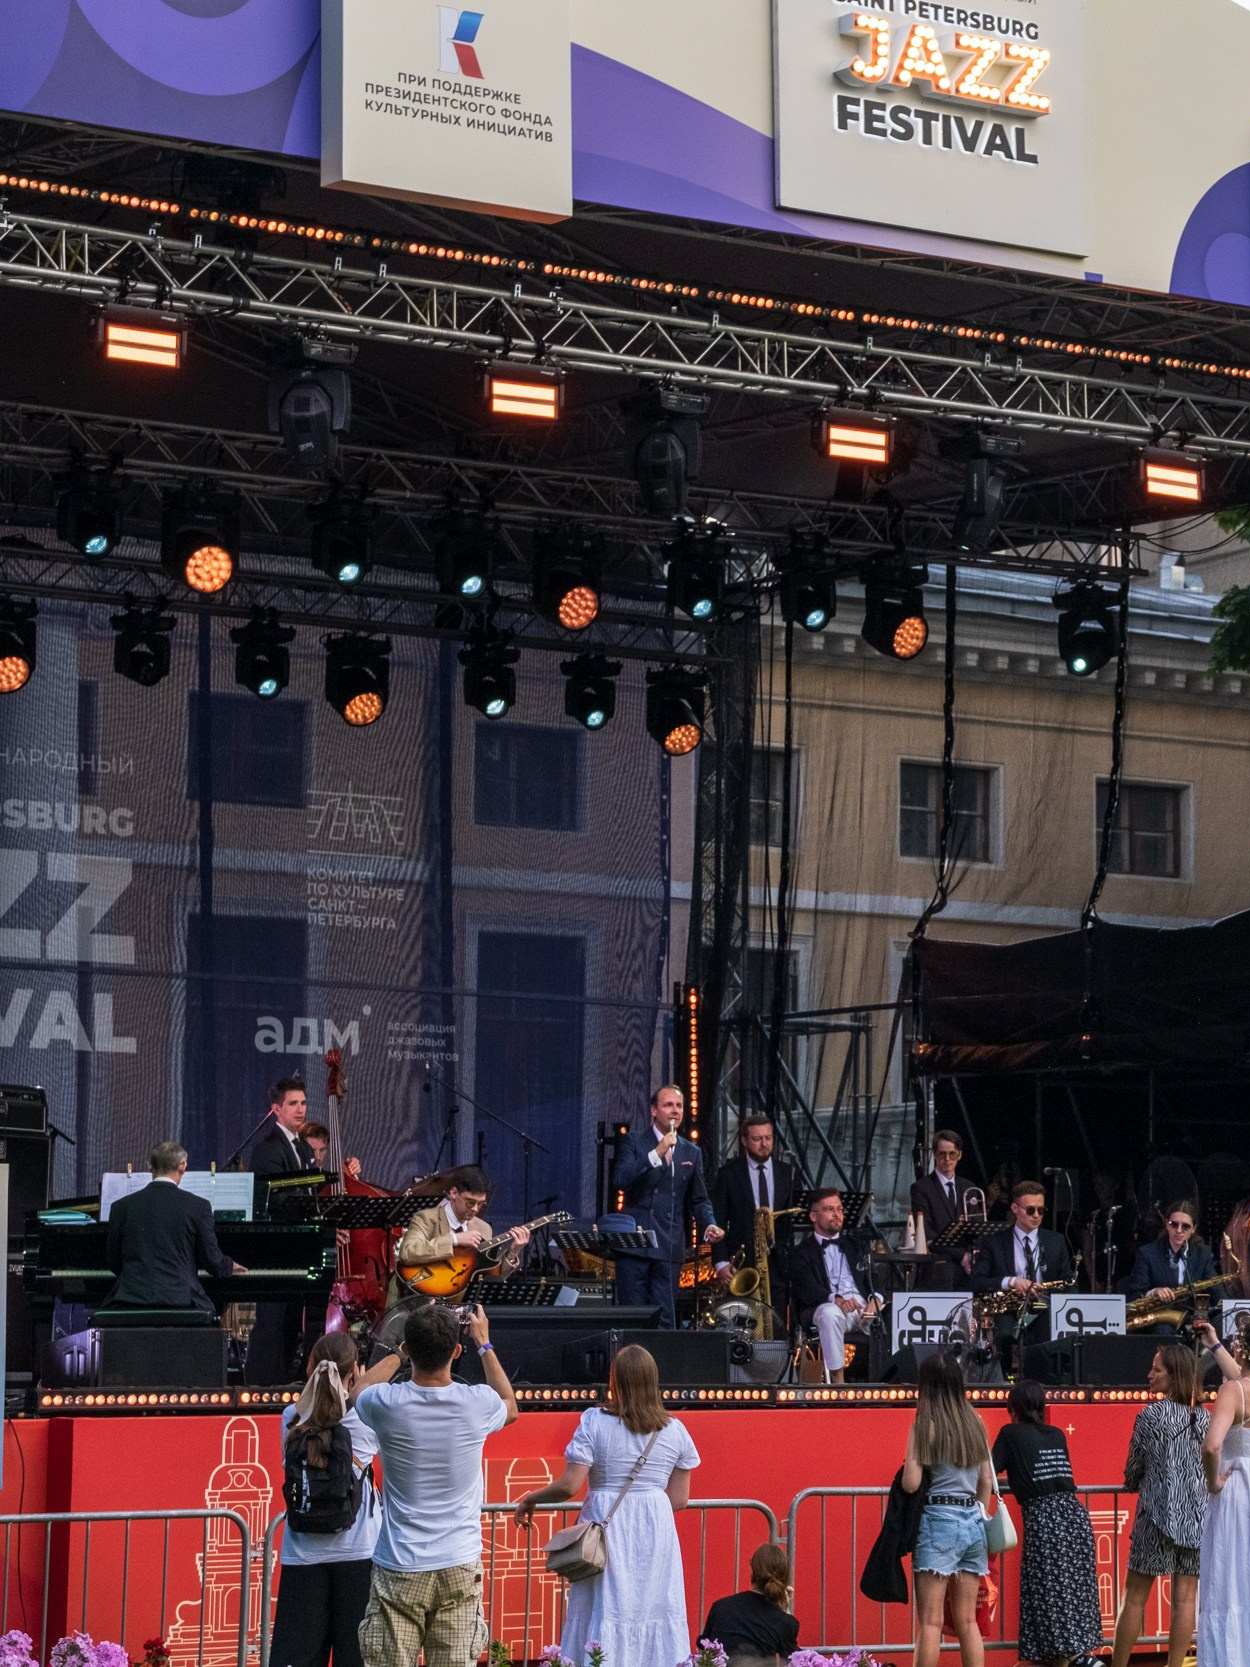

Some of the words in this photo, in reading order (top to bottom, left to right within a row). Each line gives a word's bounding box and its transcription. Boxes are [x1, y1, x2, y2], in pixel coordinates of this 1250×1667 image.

[905, 0, 1039, 40] PETERSBURG
[850, 12, 1051, 115] JAZZ
[398, 72, 427, 87] ПРИ
[432, 79, 522, 105] ПОДДЕРЖКЕ
[365, 82, 496, 116] ПРЕЗИДЕНТСКОГО
[501, 107, 553, 127] ФОНДА
[365, 99, 462, 127] КУЛЬТУРНЫХ
[467, 117, 554, 142] ИНИЦИАТИВ
[837, 94, 1039, 164] FESTIVAL
[307, 867, 375, 884] КОМИТЕТ
[307, 882, 329, 896] ПО
[332, 884, 405, 901] КУЛЬТУРЕ
[307, 913, 397, 929] ПЕТЕРБУРГА
[387, 1021, 456, 1034] ассоциация
[387, 1036, 447, 1048] джазовых
[388, 1049, 459, 1062] музыкантов
